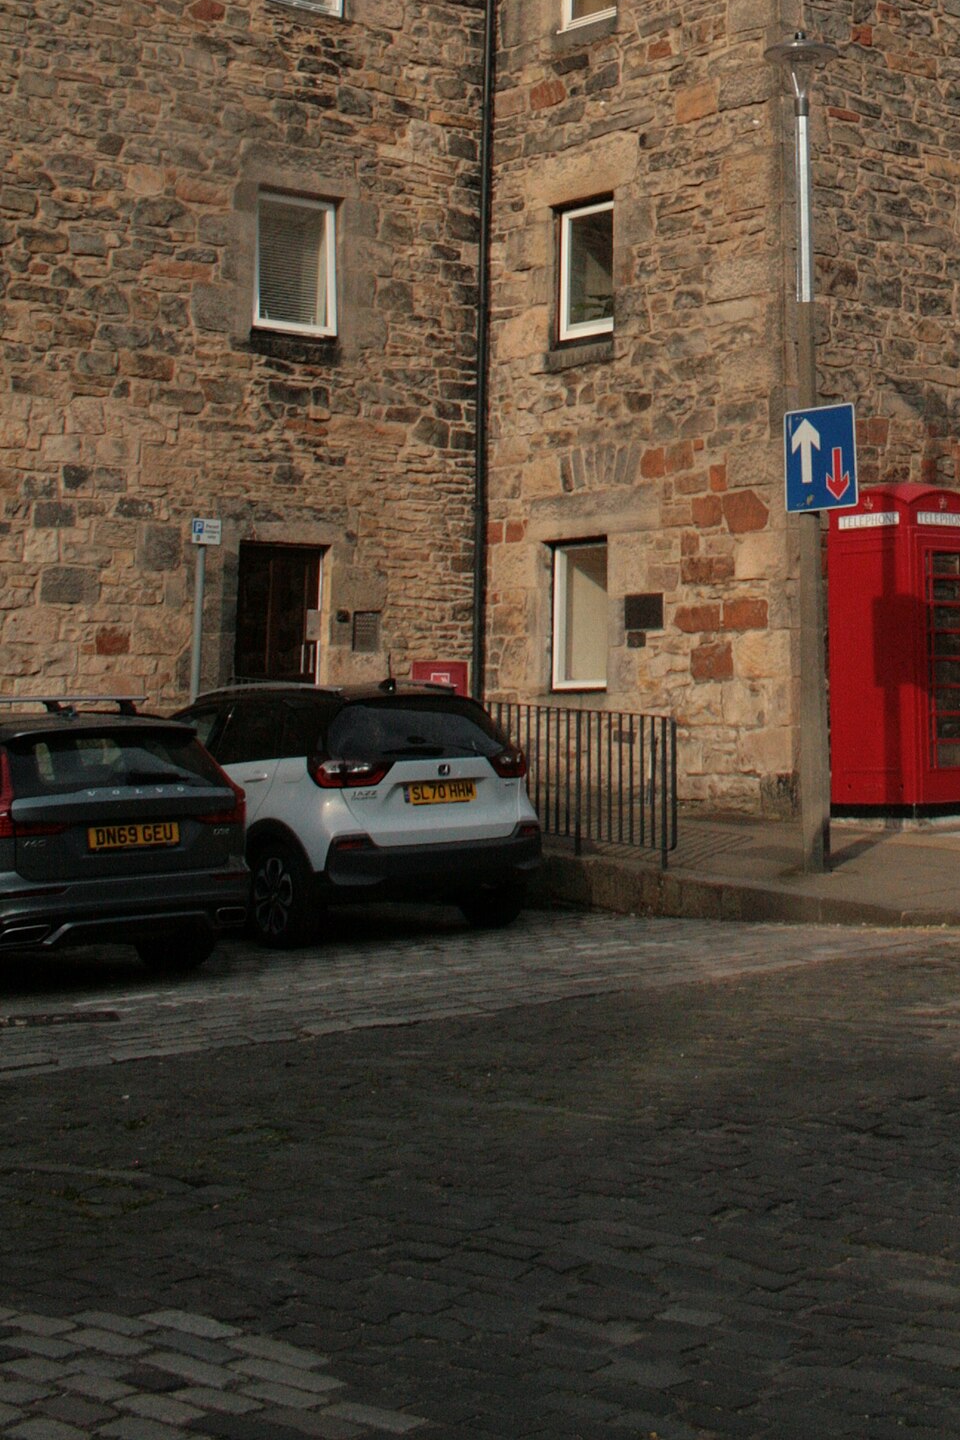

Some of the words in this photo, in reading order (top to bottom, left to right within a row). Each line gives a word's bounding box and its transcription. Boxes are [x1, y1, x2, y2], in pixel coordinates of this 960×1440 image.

[841, 511, 898, 529] TELEPHONE
[87, 786, 184, 797] VOLVO
[412, 783, 446, 801] SL70
[96, 826, 138, 846] DN69
[143, 824, 174, 842] GEU
